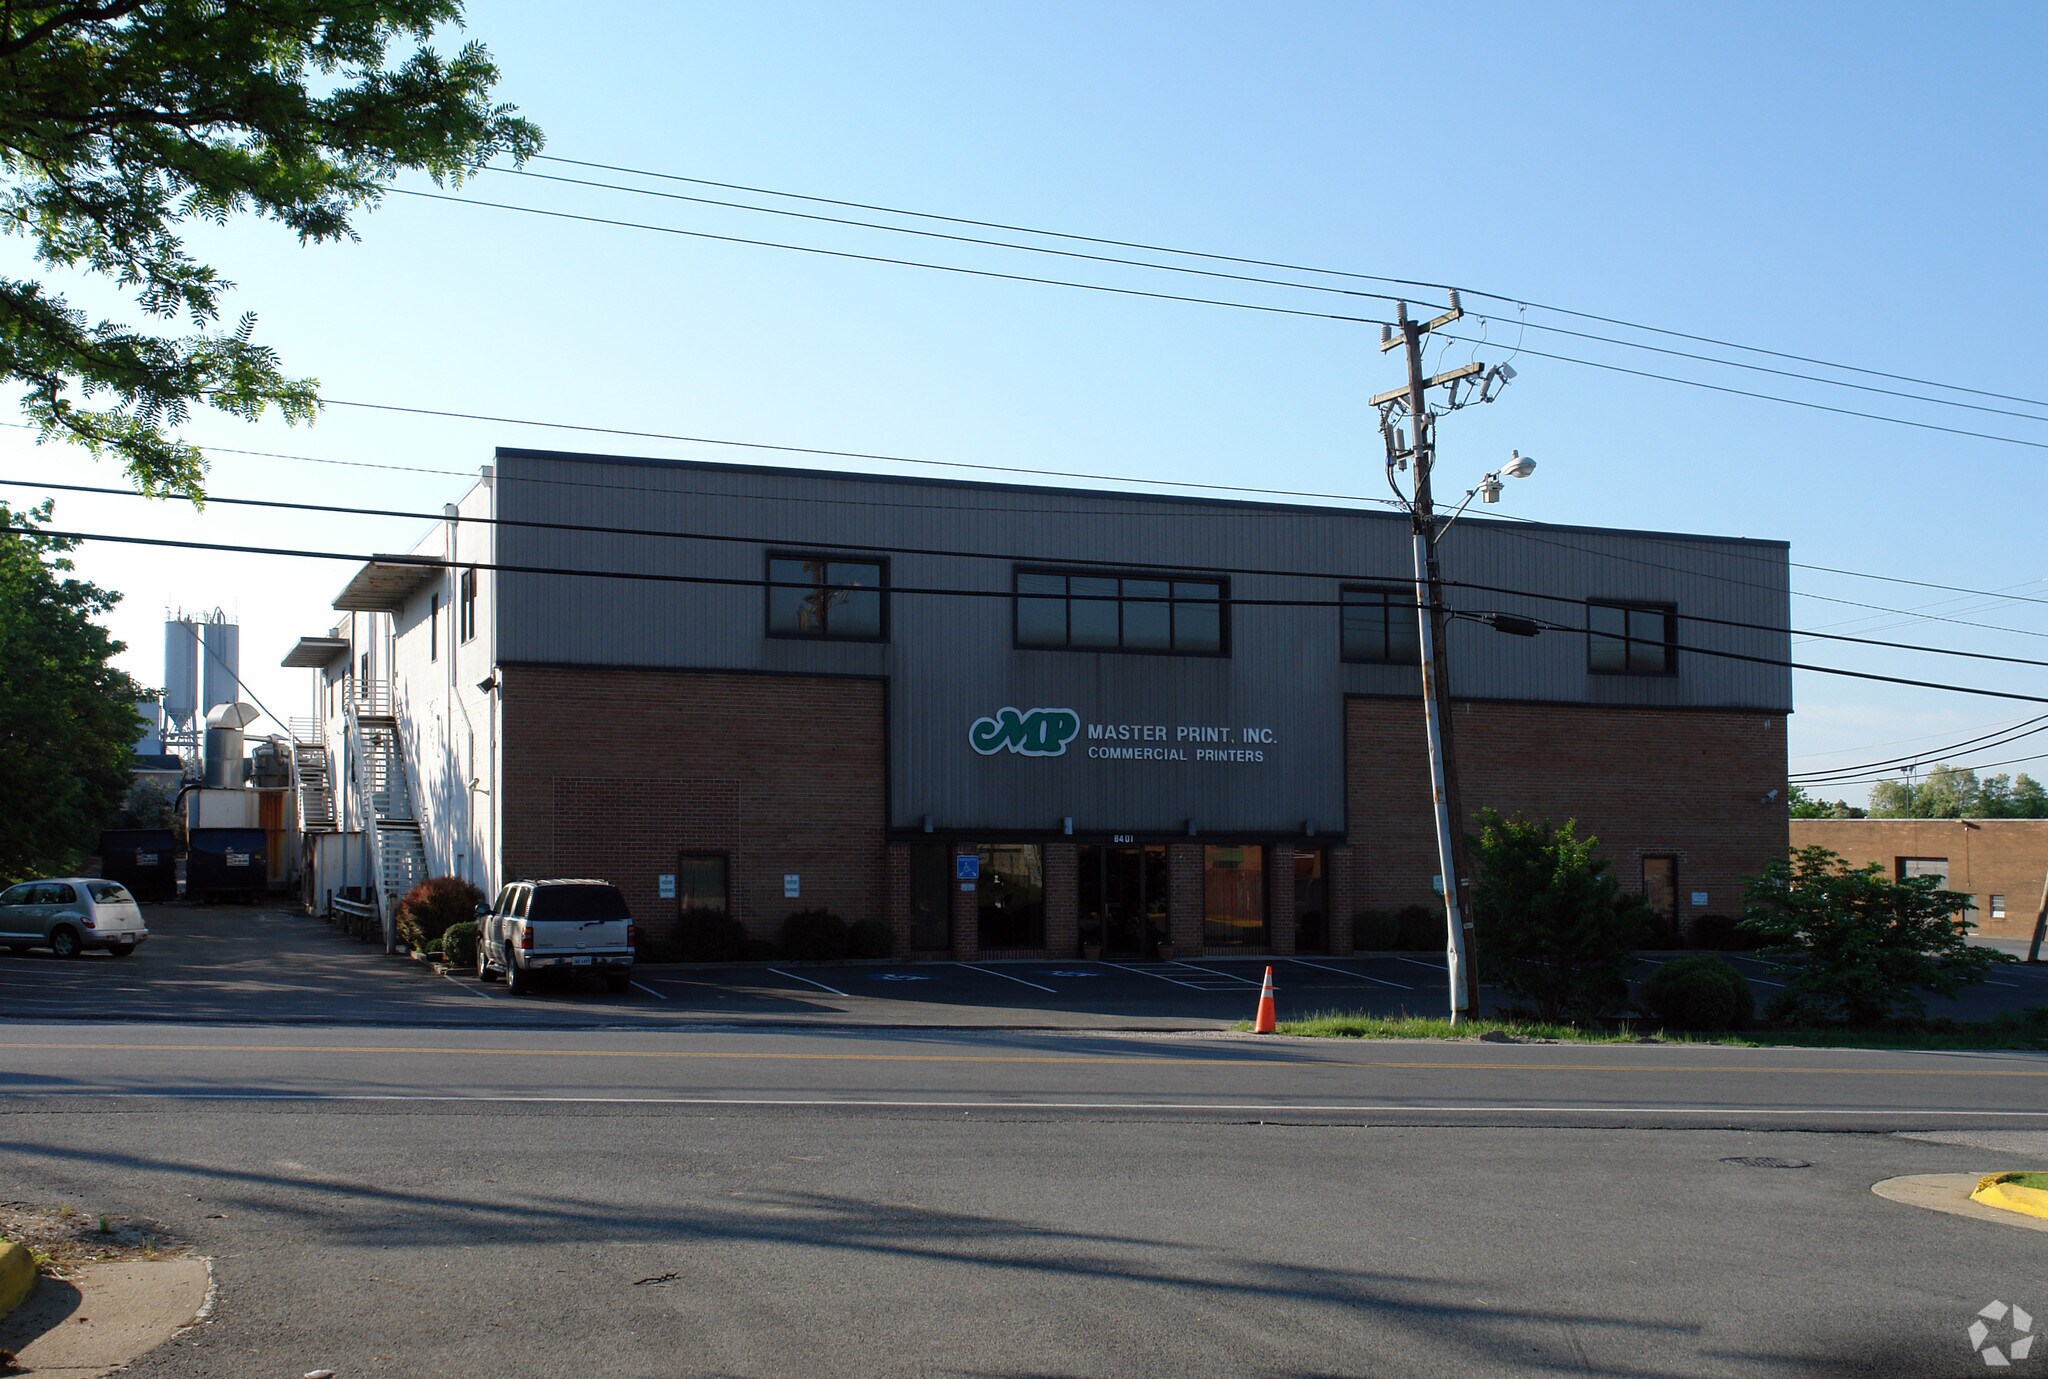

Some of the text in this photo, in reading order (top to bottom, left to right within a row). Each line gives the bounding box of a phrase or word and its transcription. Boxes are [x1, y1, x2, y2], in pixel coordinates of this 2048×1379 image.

[1087, 723, 1167, 742] MASTER
[1242, 728, 1278, 744] INC.
[1088, 747, 1264, 763] COMMERCIAL PRINTERS
[1113, 834, 1134, 843] 8401
